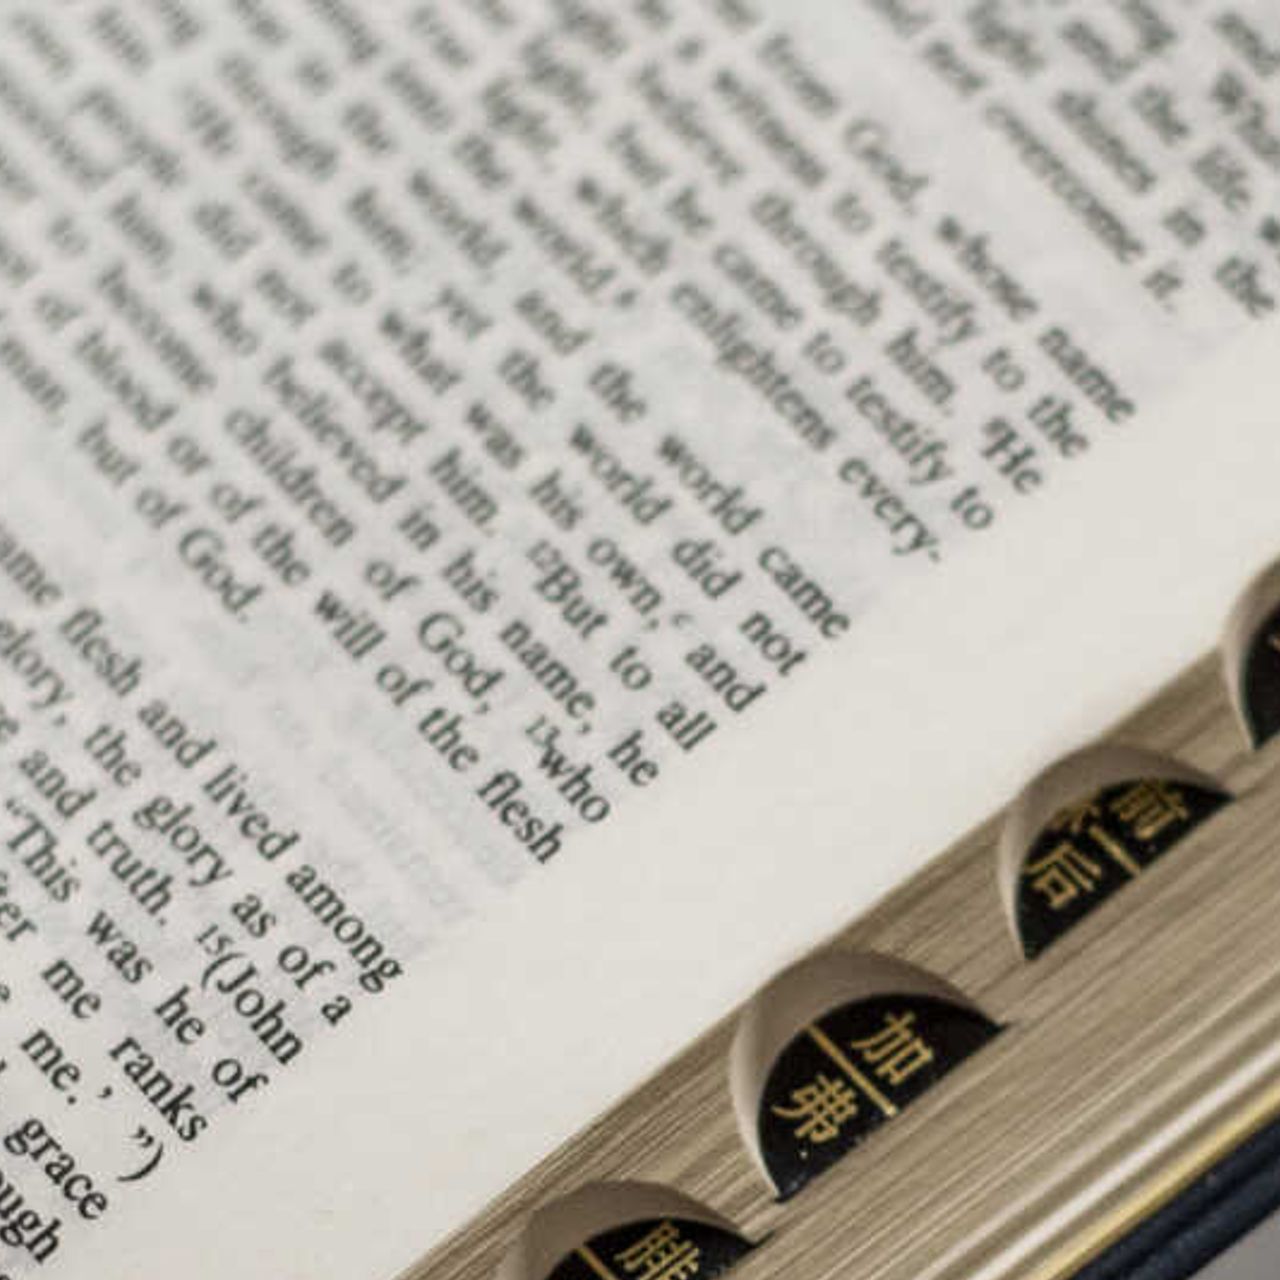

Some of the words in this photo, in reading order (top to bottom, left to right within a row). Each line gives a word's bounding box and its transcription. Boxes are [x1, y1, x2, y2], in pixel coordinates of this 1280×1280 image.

[799, 329, 847, 376] to
[843, 374, 954, 487] testify
[947, 484, 995, 531] to
[979, 345, 1027, 394] to
[1025, 393, 1090, 458] the
[1036, 325, 1136, 424] name
[176, 525, 265, 623] God.
[223, 408, 358, 549] children
[362, 558, 422, 603] of
[416, 610, 506, 715] God,
[377, 308, 464, 397] what
[462, 399, 526, 471] was
[526, 467, 585, 532] his
[683, 642, 767, 714] and
[566, 421, 675, 526] world
[669, 538, 744, 601] did
[737, 609, 808, 677] not
[586, 360, 648, 424] the
[654, 432, 765, 537] world
[756, 545, 851, 639] came
[836, 455, 940, 562] every-
[206, 481, 266, 525] of
[249, 521, 312, 587] the
[312, 588, 387, 661] will
[374, 662, 435, 708] of
[416, 706, 480, 772] the
[475, 768, 564, 865] flesh
[395, 502, 442, 553] in
[439, 546, 500, 615] his
[497, 617, 596, 736] name,
[605, 727, 659, 787] he
[426, 445, 499, 528] him.
[608, 644, 653, 691] to
[654, 699, 718, 752] all
[16, 748, 98, 821] and
[85, 819, 175, 927] truth.
[57, 605, 143, 699] flesh
[135, 699, 219, 770] and
[201, 762, 301, 862] lived
[284, 863, 404, 994] among
[82, 722, 143, 789] the
[131, 795, 233, 888] glory
[228, 893, 277, 939] as
[276, 943, 337, 991] of
[319, 994, 352, 1027] a
[1017, 840, 1102, 910] 后
[1110, 763, 1190, 841] 前
[40, 957, 102, 1020] me
[107, 1035, 208, 1142] ranks
[85, 909, 154, 985] was
[152, 984, 206, 1046] he
[210, 1057, 270, 1105] of
[850, 1012, 934, 1086] 加
[2, 1117, 108, 1221] grace
[770, 1073, 858, 1143] 弗
